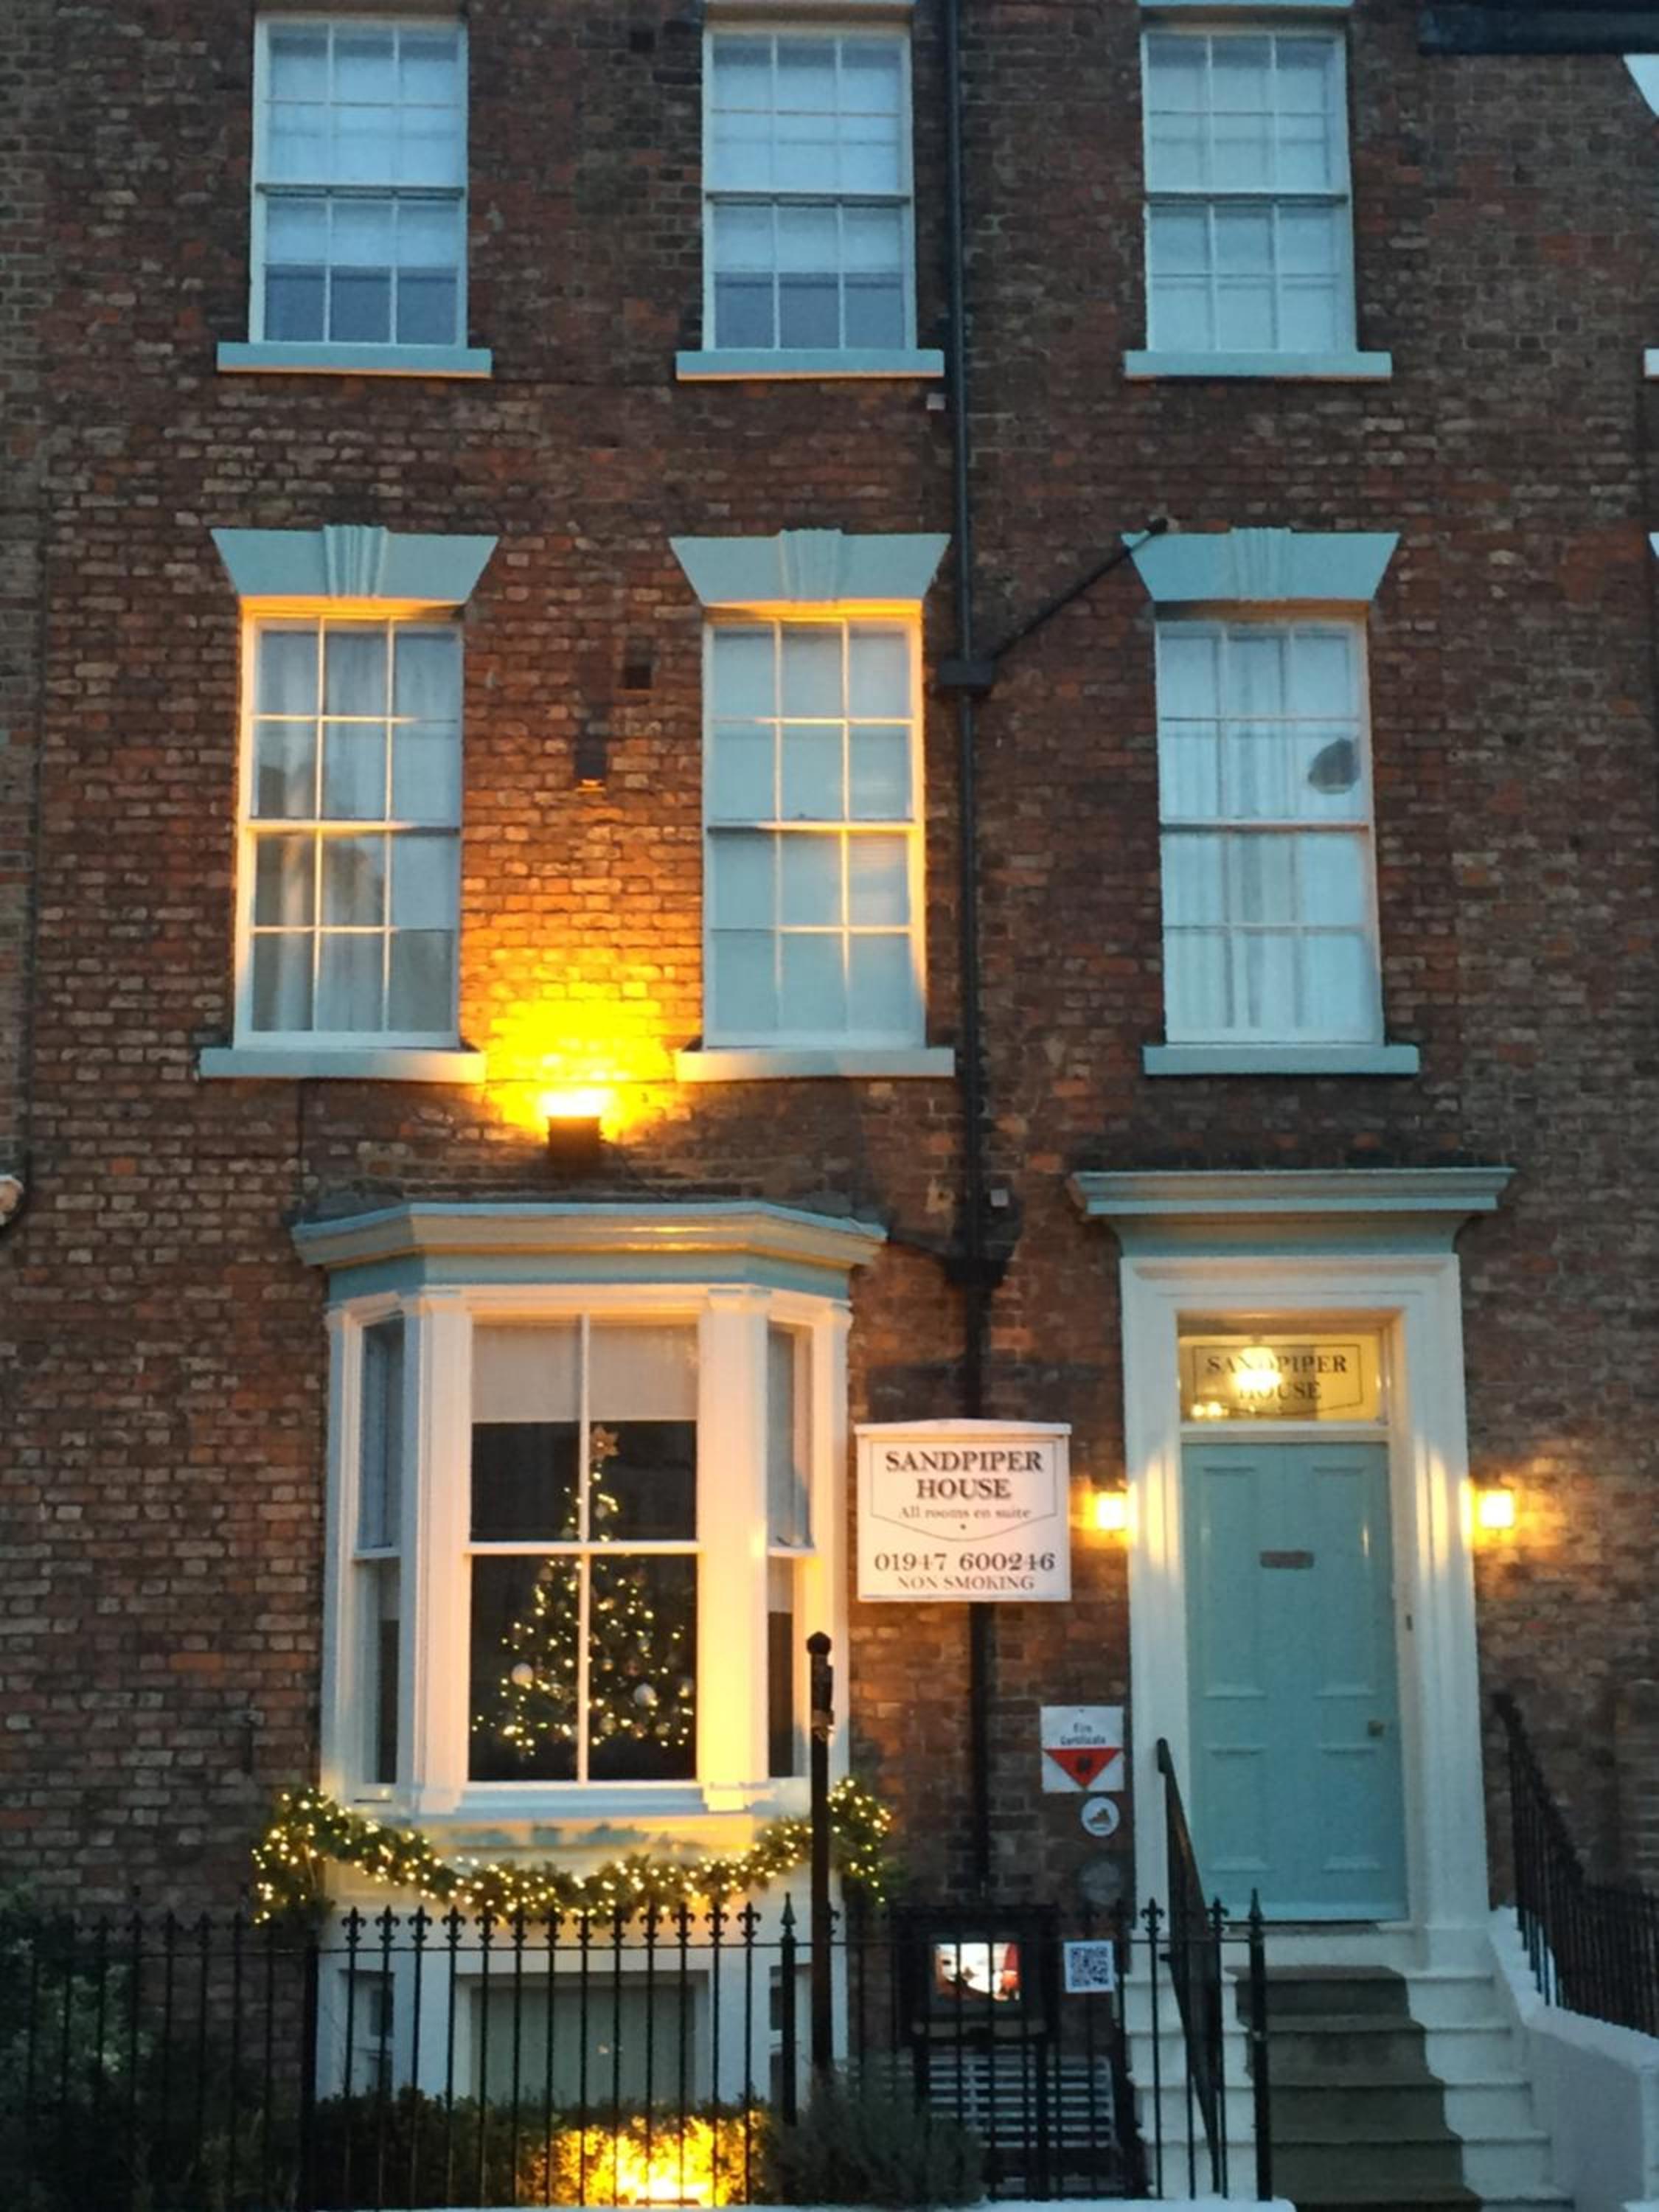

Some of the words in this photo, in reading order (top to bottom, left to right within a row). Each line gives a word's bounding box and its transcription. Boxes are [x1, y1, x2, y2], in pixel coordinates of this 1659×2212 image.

[885, 1450, 1043, 1472] SANDPIPER
[917, 1478, 1012, 1499] HOUSE
[899, 1506, 920, 1519] All
[925, 1509, 970, 1519] rooms
[973, 1509, 992, 1519] en
[995, 1507, 1031, 1519] suite
[897, 1576, 939, 1590] NON
[943, 1576, 1035, 1590] SMOKING
